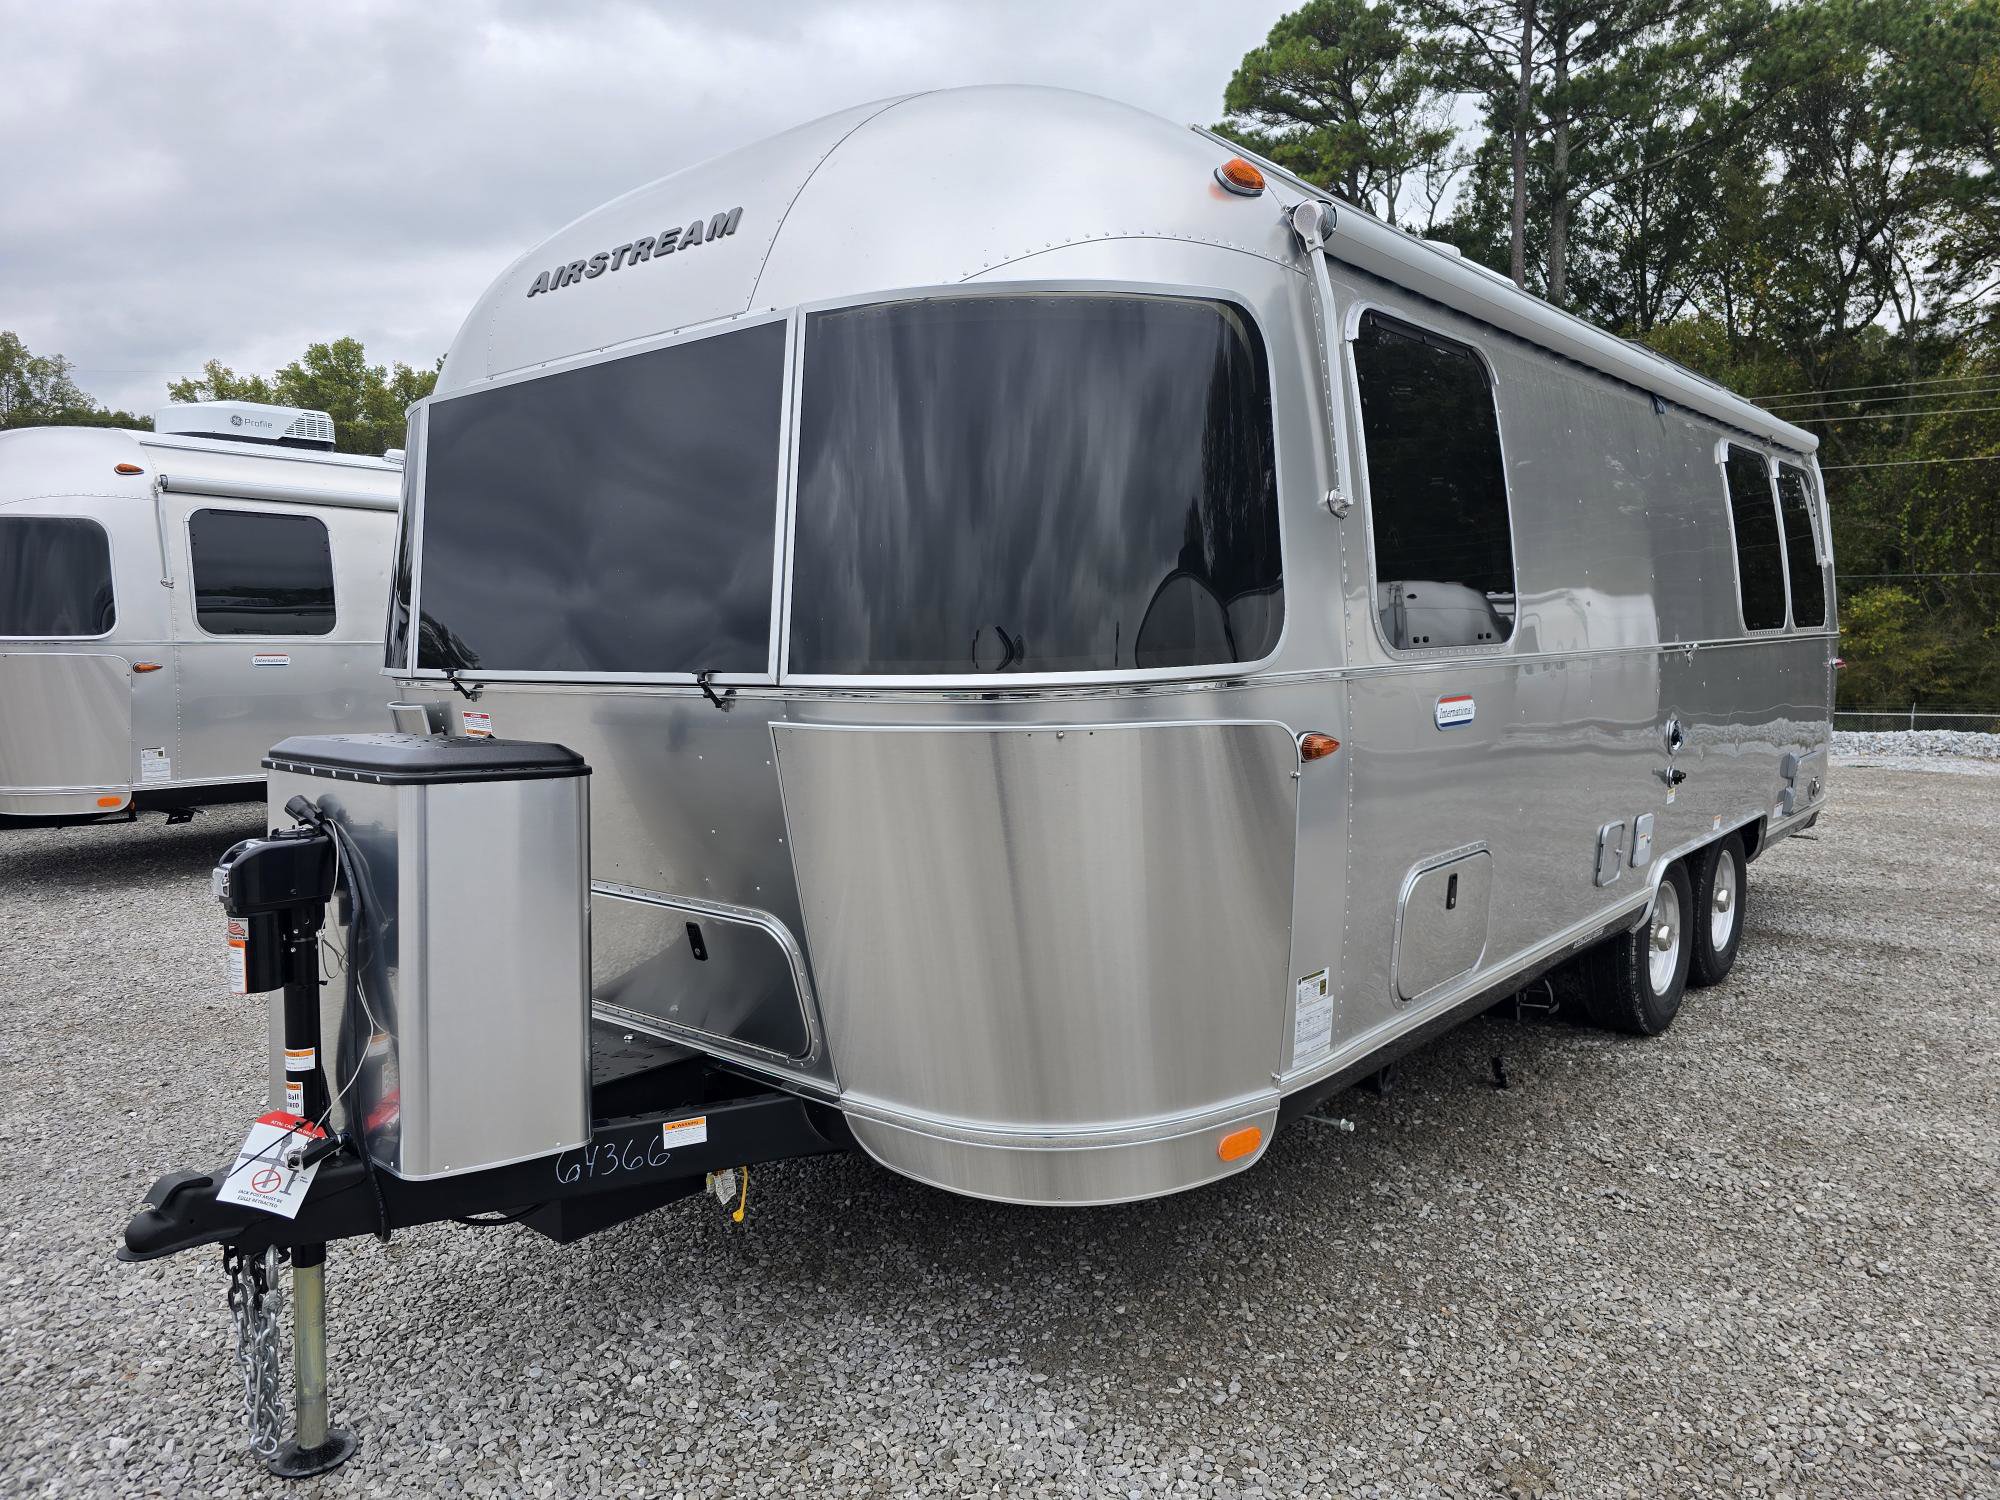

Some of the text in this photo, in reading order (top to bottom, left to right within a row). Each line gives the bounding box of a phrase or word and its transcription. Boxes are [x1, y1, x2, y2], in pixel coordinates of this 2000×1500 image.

[526, 206, 743, 298] AIRSTREAM
[244, 418, 273, 429] Profile
[1439, 703, 1474, 719] International
[556, 1136, 671, 1184] 64366
